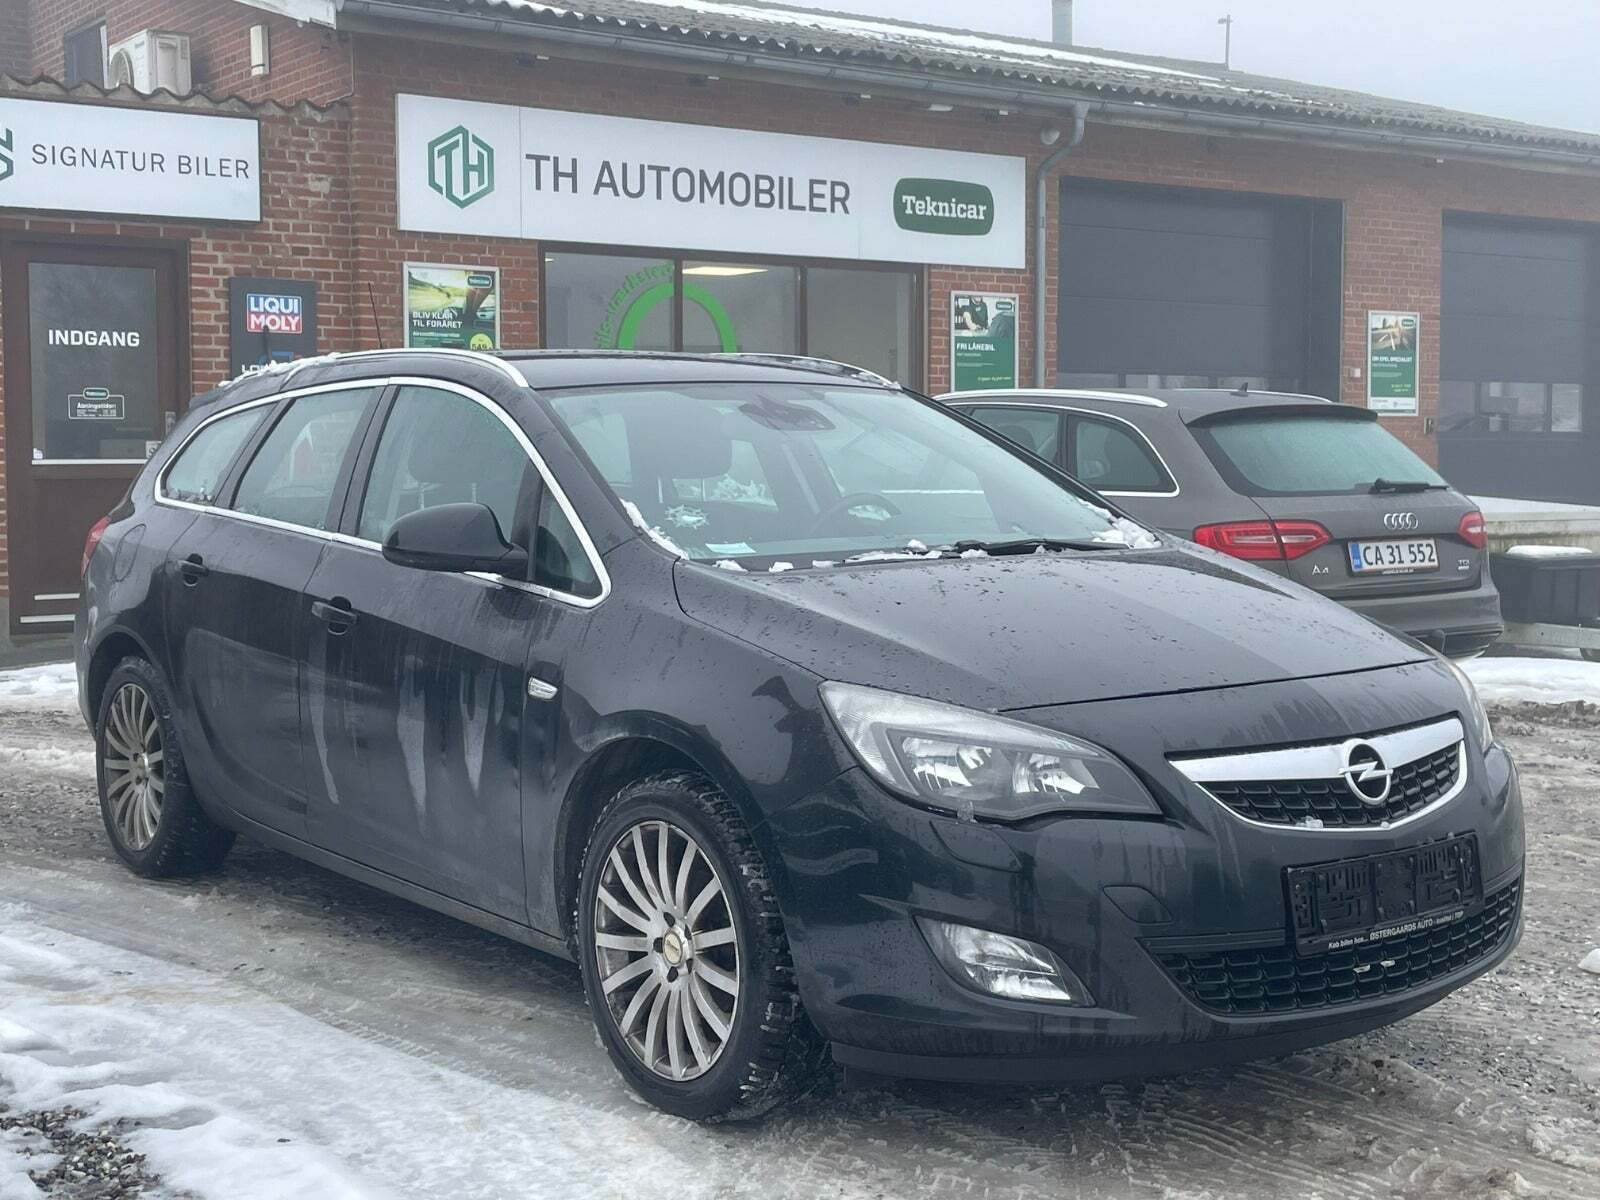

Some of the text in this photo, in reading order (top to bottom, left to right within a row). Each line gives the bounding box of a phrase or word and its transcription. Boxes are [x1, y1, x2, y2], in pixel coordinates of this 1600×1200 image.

[32, 144, 165, 173] SIGNATUR
[178, 155, 249, 179] BILER
[525, 153, 850, 214] TH AUTOMOBILER
[902, 195, 987, 220] Teknicar
[250, 296, 299, 314] LIQUI
[250, 313, 300, 331] MOLY
[48, 329, 140, 347] INDGANG
[1363, 543, 1436, 566] CA 31 552
[1417, 918, 1434, 930] AUTO
